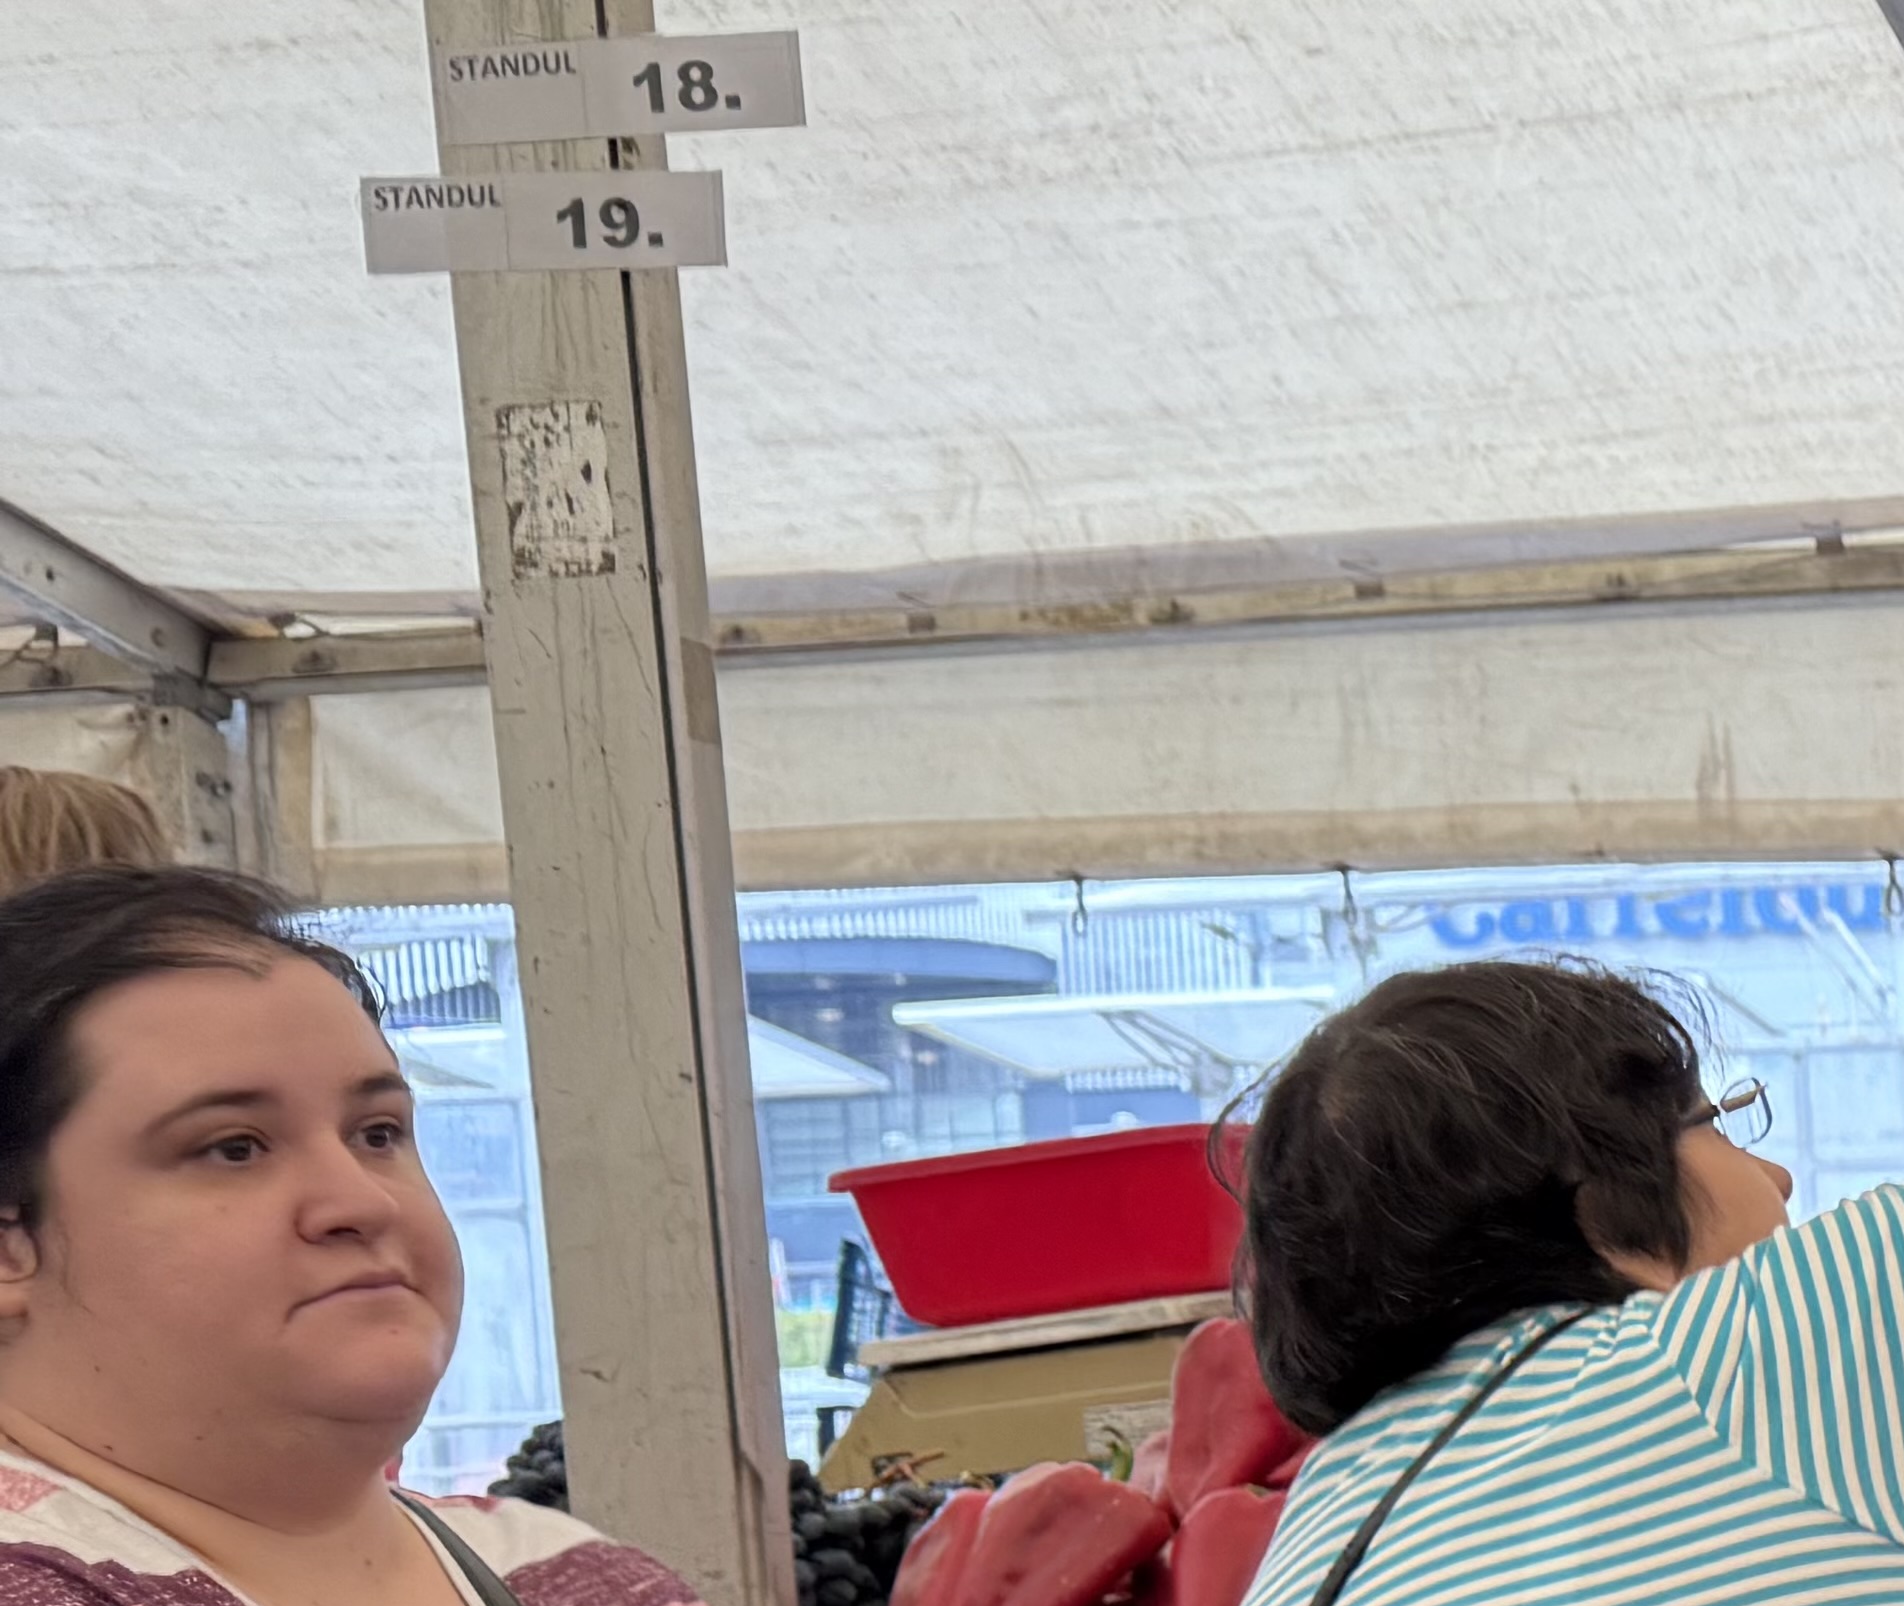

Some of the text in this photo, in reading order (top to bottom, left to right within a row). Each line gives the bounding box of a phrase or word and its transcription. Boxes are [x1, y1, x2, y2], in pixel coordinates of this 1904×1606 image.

[449, 51, 742, 114] STANDUL 18.
[373, 183, 664, 249] STANDUL 19.
